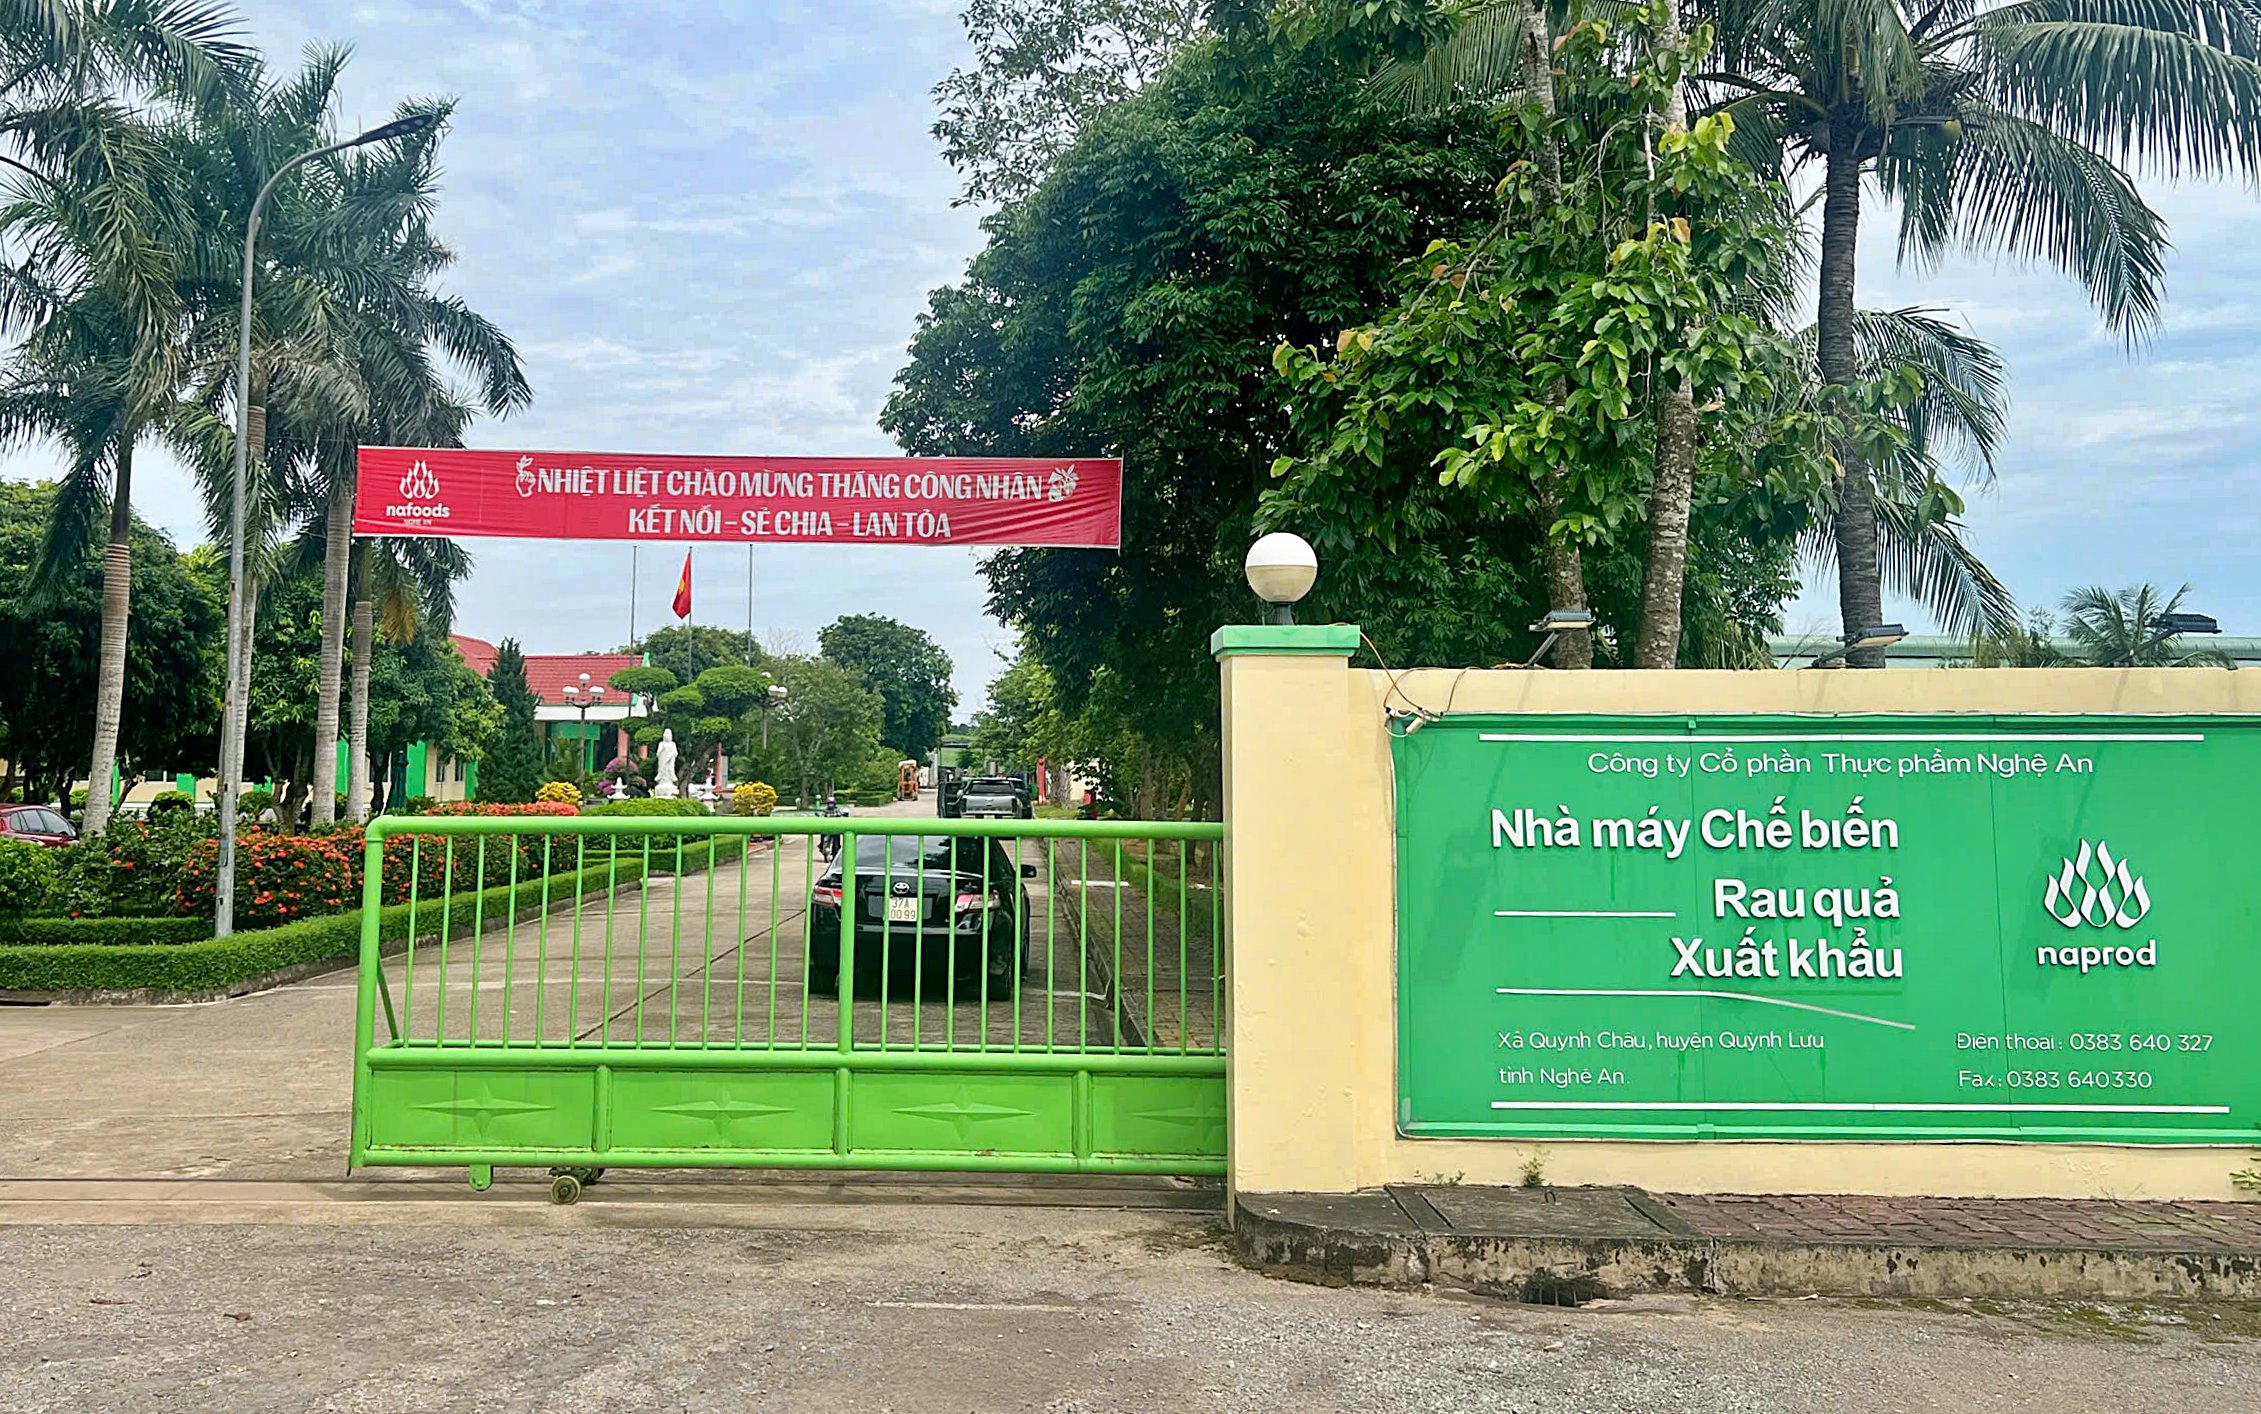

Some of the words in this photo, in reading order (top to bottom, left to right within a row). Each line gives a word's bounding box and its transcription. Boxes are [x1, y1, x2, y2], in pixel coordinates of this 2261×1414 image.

[537, 466, 610, 497] NHIỆT
[613, 467, 664, 498] LIỆT
[667, 468, 736, 497] CHÀO
[740, 469, 813, 498] MỪNG
[817, 470, 900, 499] THÁNG
[904, 471, 972, 500] CÔNG
[976, 471, 1043, 500] NHÂN
[386, 501, 450, 518] nafoods
[628, 503, 677, 534] KẾT
[680, 504, 722, 534] NỐI
[740, 507, 771, 537] SẺ
[774, 510, 833, 537] CHIA
[853, 511, 898, 538] LAN
[902, 508, 951, 539] TỎA
[1588, 752, 1658, 778] Công
[1666, 754, 1691, 777] ty
[1699, 747, 1738, 773] Cổ
[1747, 749, 1811, 778] phần
[1821, 753, 1892, 778] Thực
[1898, 748, 1971, 778] phẩm
[1977, 753, 2047, 778] Nghệ
[2055, 753, 2093, 773] An
[1491, 804, 1580, 847] Nhà
[1593, 805, 1691, 859] máy
[1701, 795, 1793, 848] Chế
[1714, 878, 1805, 918] Rau
[1813, 876, 1900, 927] quả
[1670, 927, 1779, 977] Xuất
[1788, 925, 1902, 978] khẩu
[2037, 939, 2157, 974] naprod
[1656, 1031, 1714, 1052] huyện
[1788, 1031, 1824, 1048] Lưu
[2069, 1033, 2122, 1051] 0383
[2129, 1033, 2171, 1051] 640
[2178, 1034, 2214, 1051] 327
[2007, 1070, 2060, 1088] 0383
[2067, 1071, 2153, 1088] 640330
